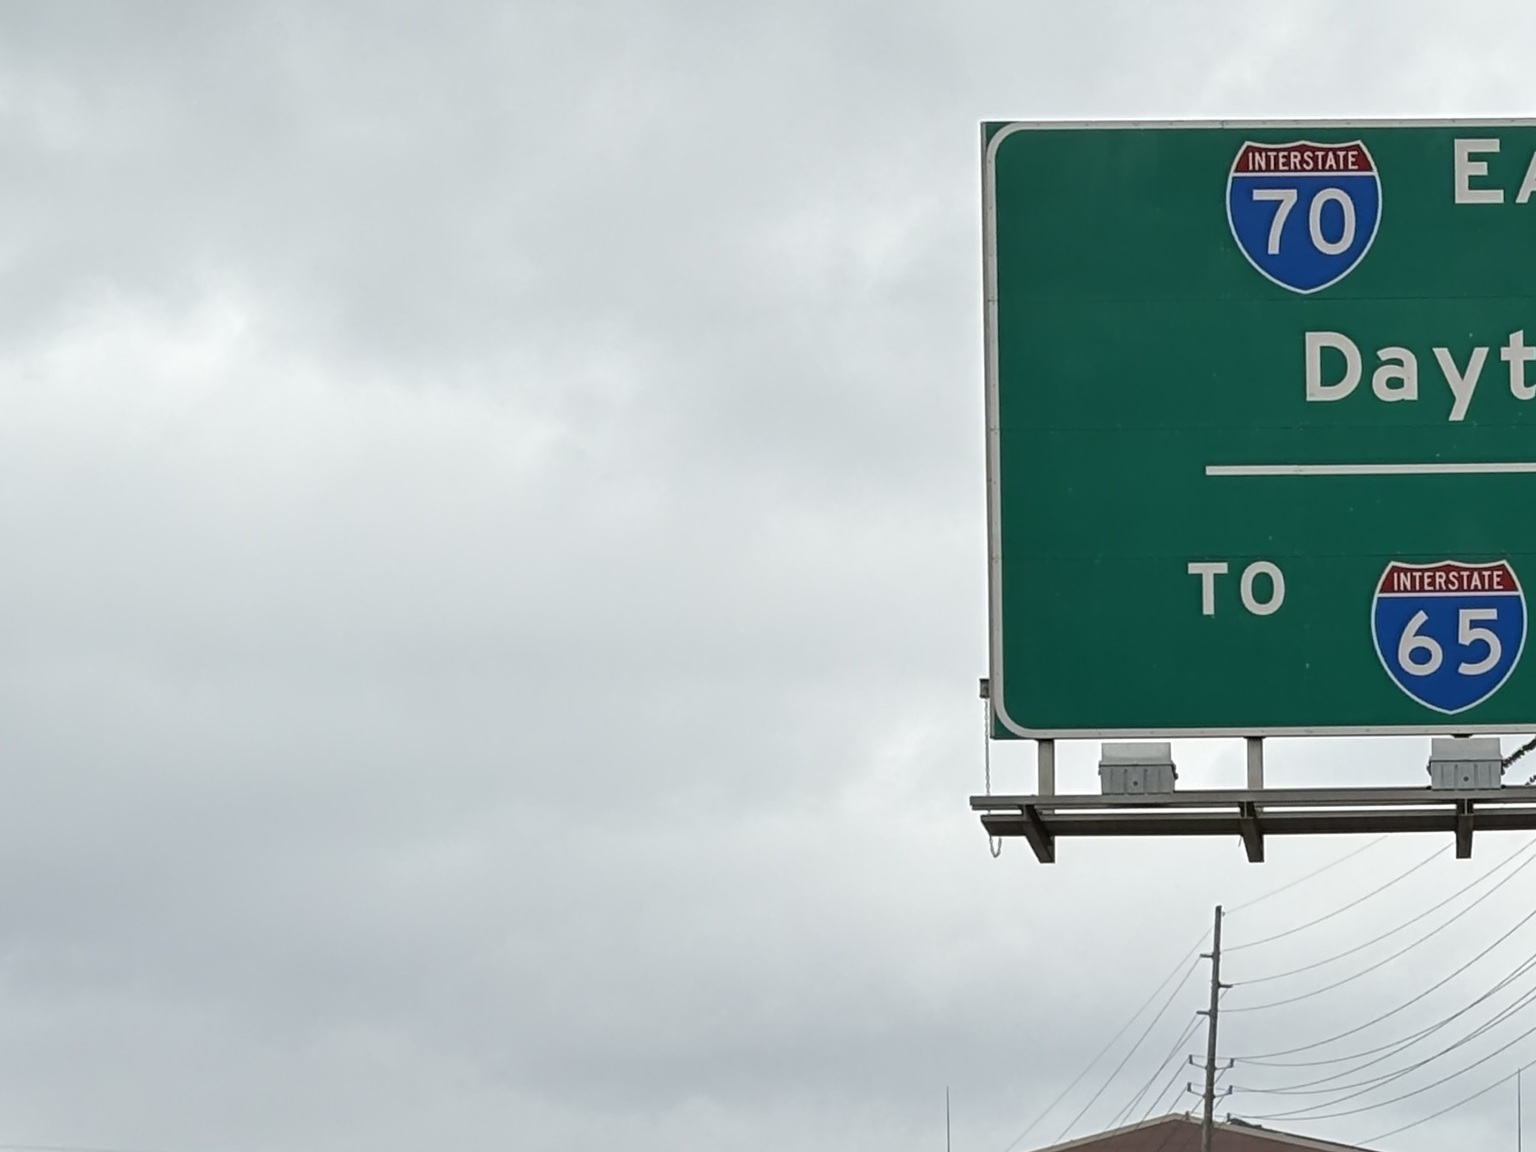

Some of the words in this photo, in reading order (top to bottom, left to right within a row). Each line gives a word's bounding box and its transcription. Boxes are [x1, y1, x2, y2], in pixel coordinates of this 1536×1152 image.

[1248, 151, 1359, 171] INTERSTATE
[1252, 187, 1356, 256] 70
[1188, 561, 1286, 616] TO
[1393, 571, 1504, 591] INTERSTATE
[1398, 608, 1502, 676] 65
